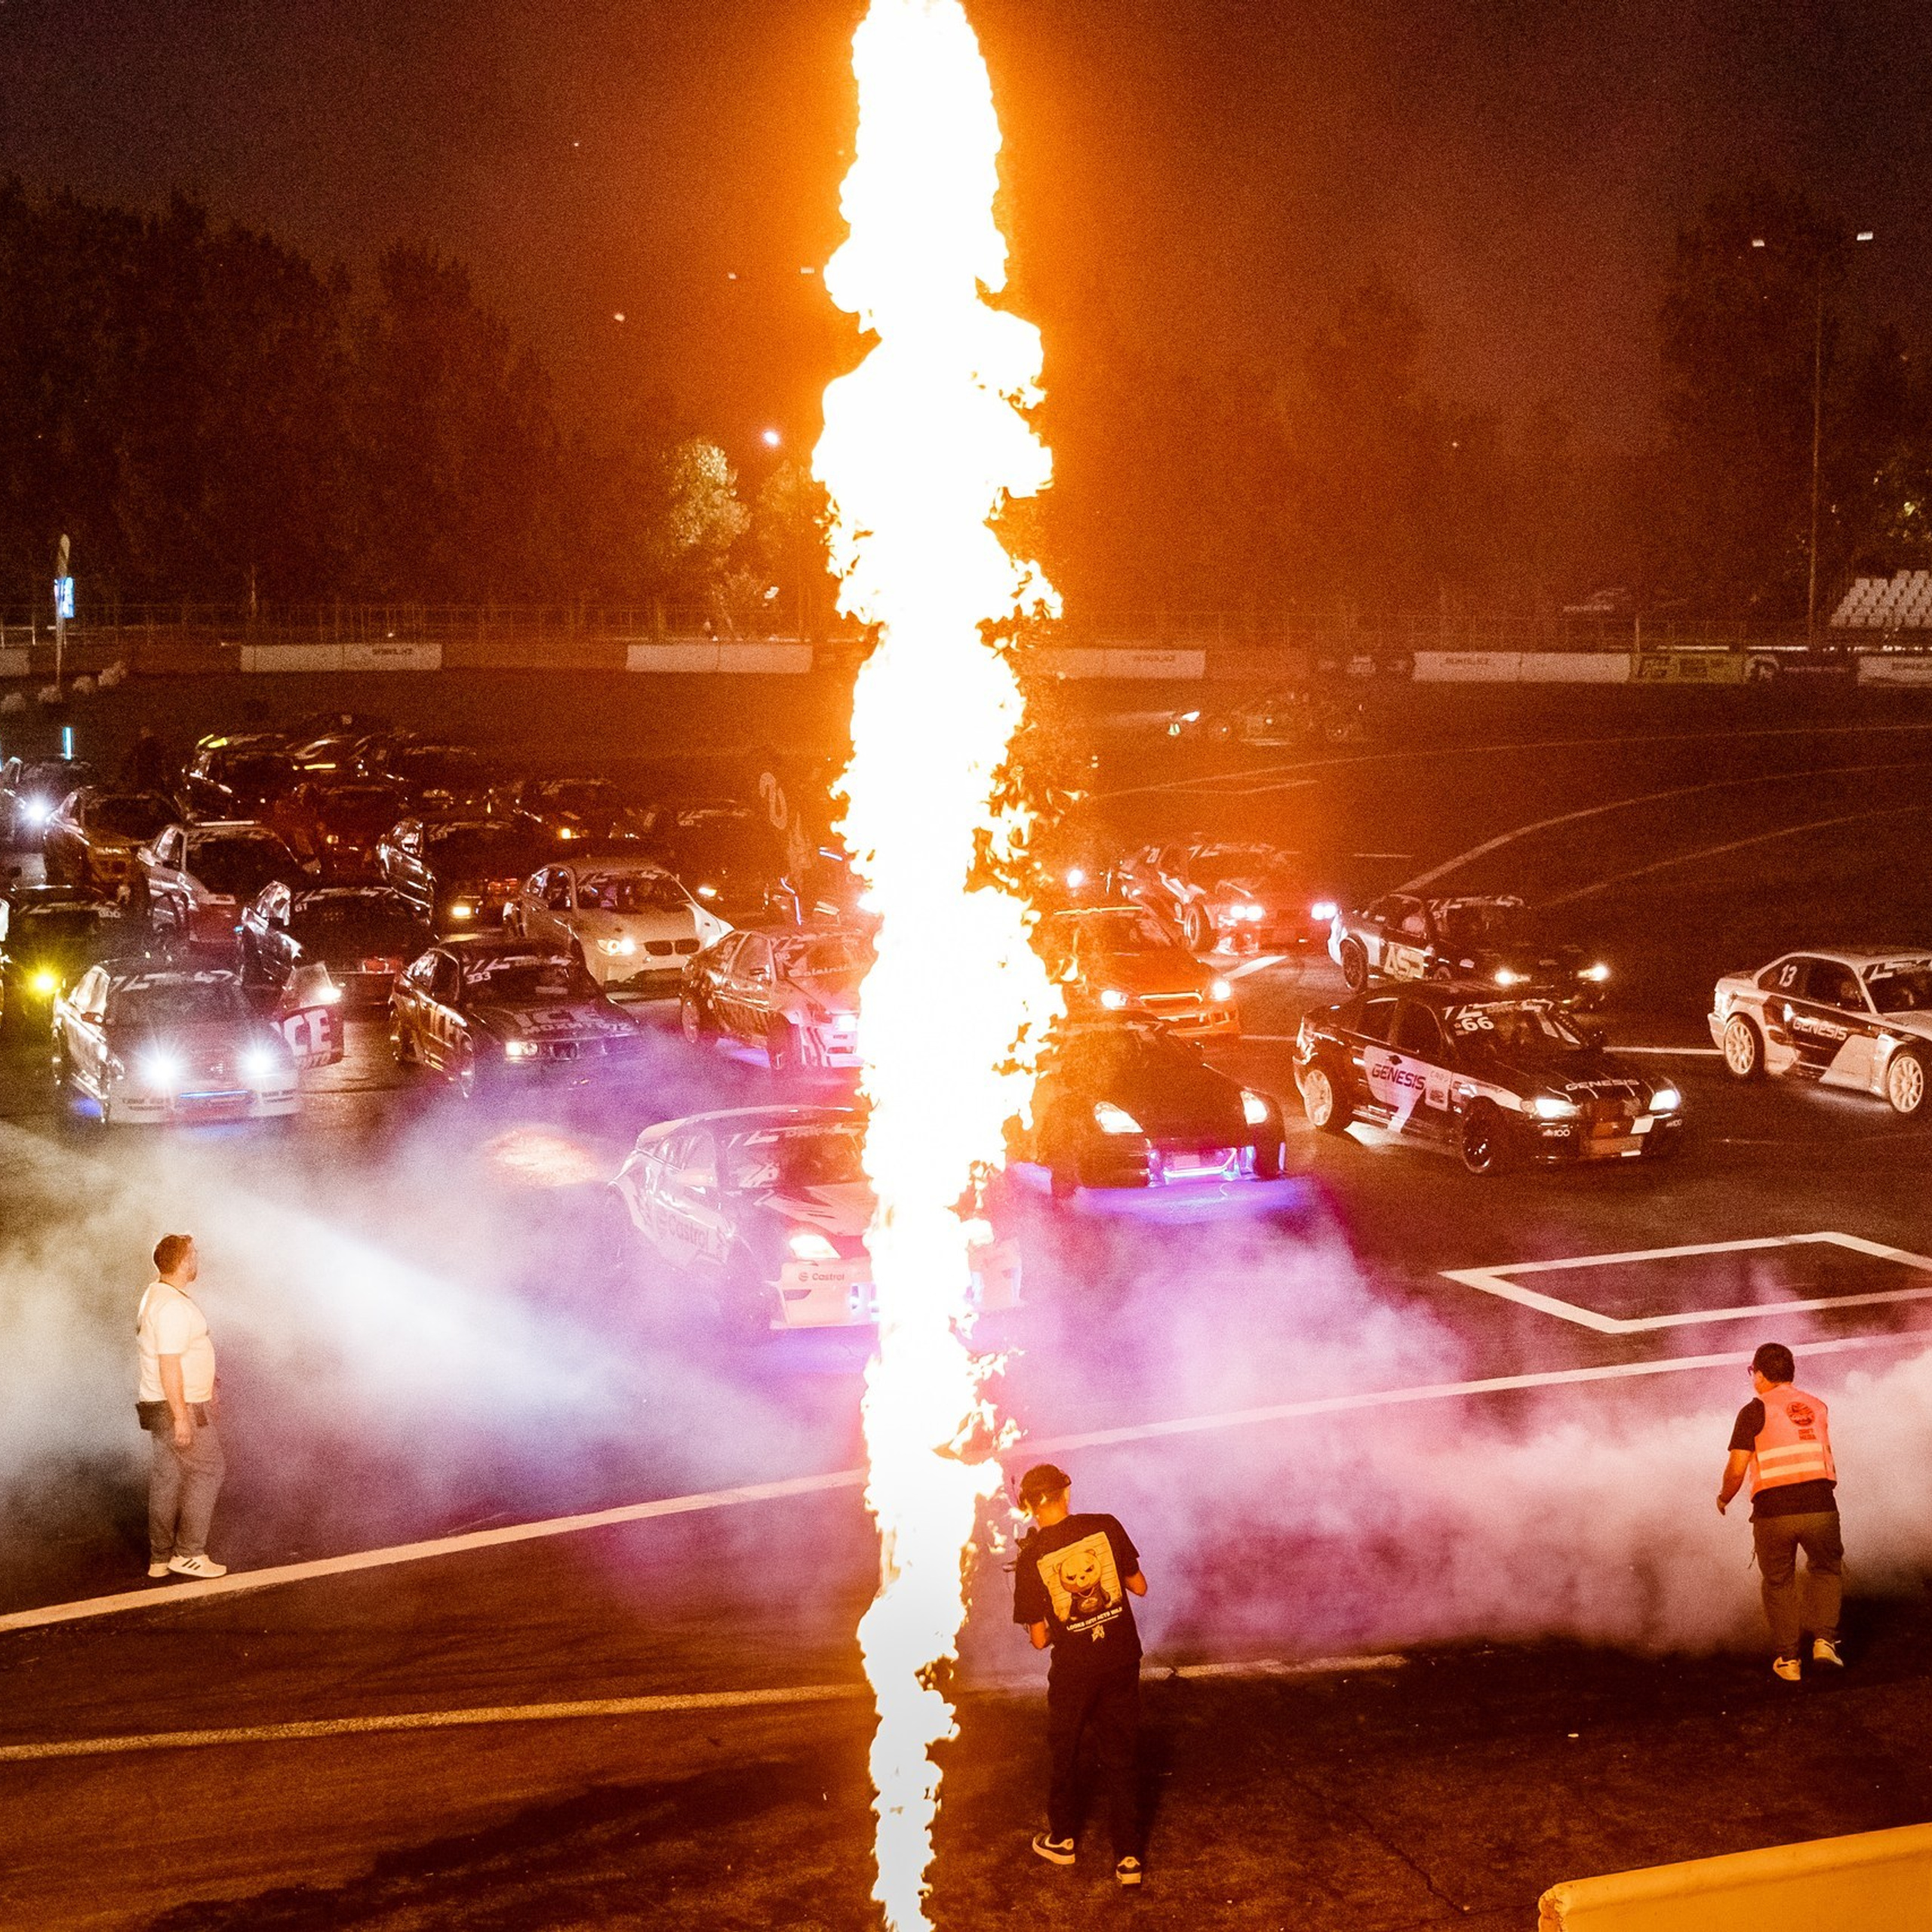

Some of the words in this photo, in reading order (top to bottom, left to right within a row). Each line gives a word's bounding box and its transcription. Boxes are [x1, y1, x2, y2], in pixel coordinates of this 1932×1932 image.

[1778, 964, 1798, 987] 13
[269, 1009, 331, 1057] CE
[1462, 1016, 1494, 1032] 66
[1792, 1017, 1848, 1041] GENESIS
[1371, 1063, 1426, 1091] GENESIS
[1565, 1079, 1640, 1091] GENESIS
[669, 1214, 709, 1252] Castrol
[812, 1272, 845, 1281] Castrol
